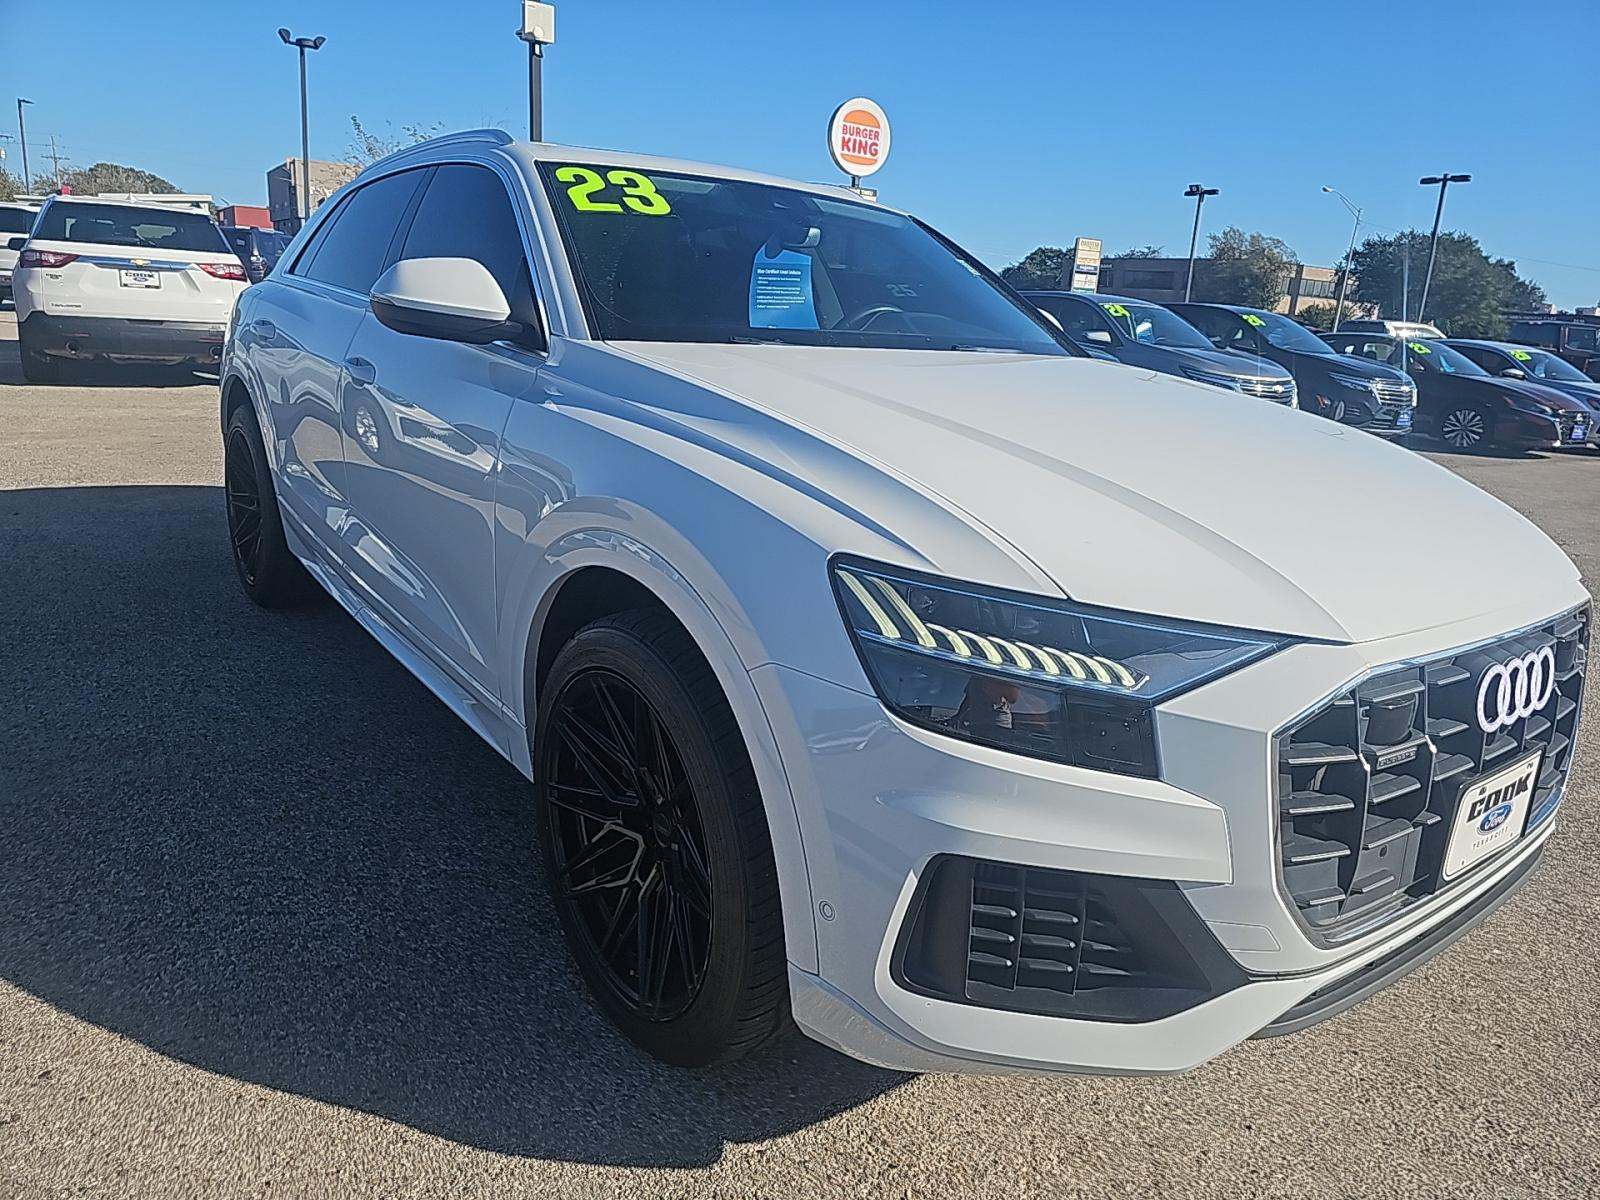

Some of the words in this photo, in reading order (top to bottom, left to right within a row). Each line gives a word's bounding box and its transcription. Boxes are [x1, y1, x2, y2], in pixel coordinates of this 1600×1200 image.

[842, 124, 880, 141] BURGER
[841, 136, 879, 157] KING
[555, 167, 671, 215] 23
[1466, 772, 1532, 823] COOK
[1484, 808, 1508, 829] Ford
